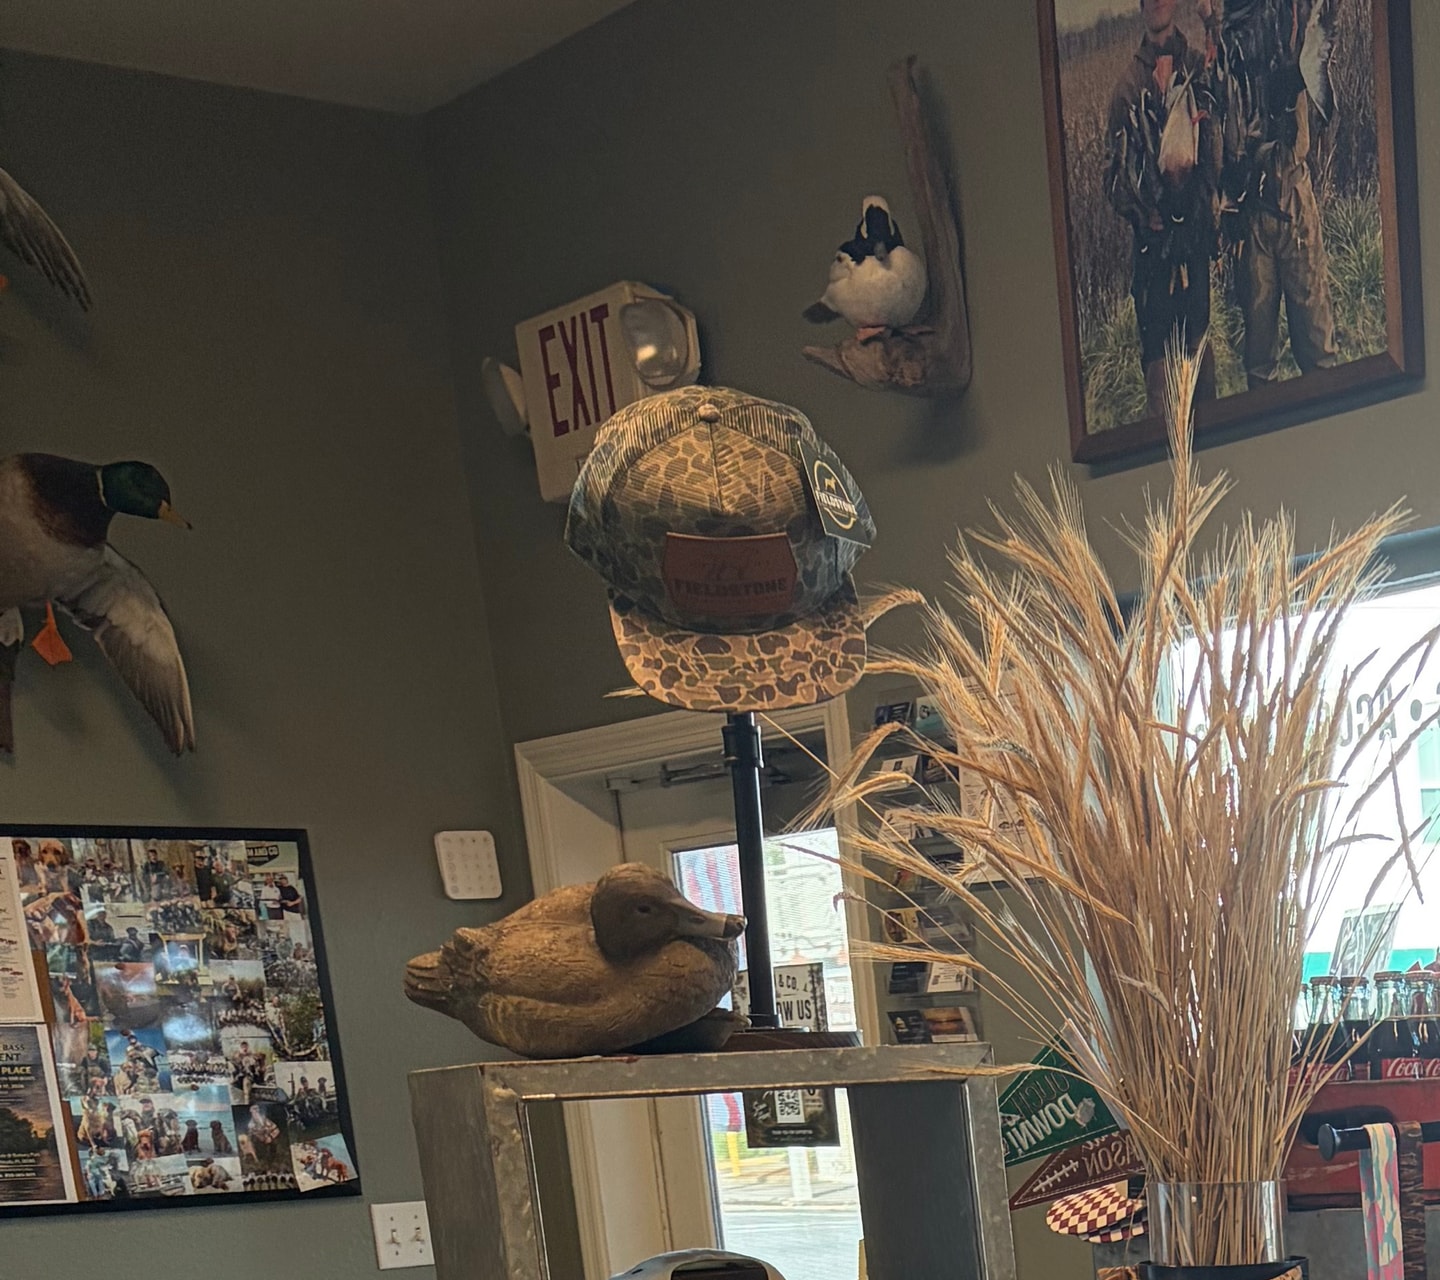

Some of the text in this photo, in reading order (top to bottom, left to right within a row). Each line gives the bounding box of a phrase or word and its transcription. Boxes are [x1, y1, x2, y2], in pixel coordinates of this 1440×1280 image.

[538, 303, 617, 438] EXIT
[797, 1000, 812, 1020] US
[3, 1043, 25, 1051] BASS
[1, 1066, 31, 1075] PLACE
